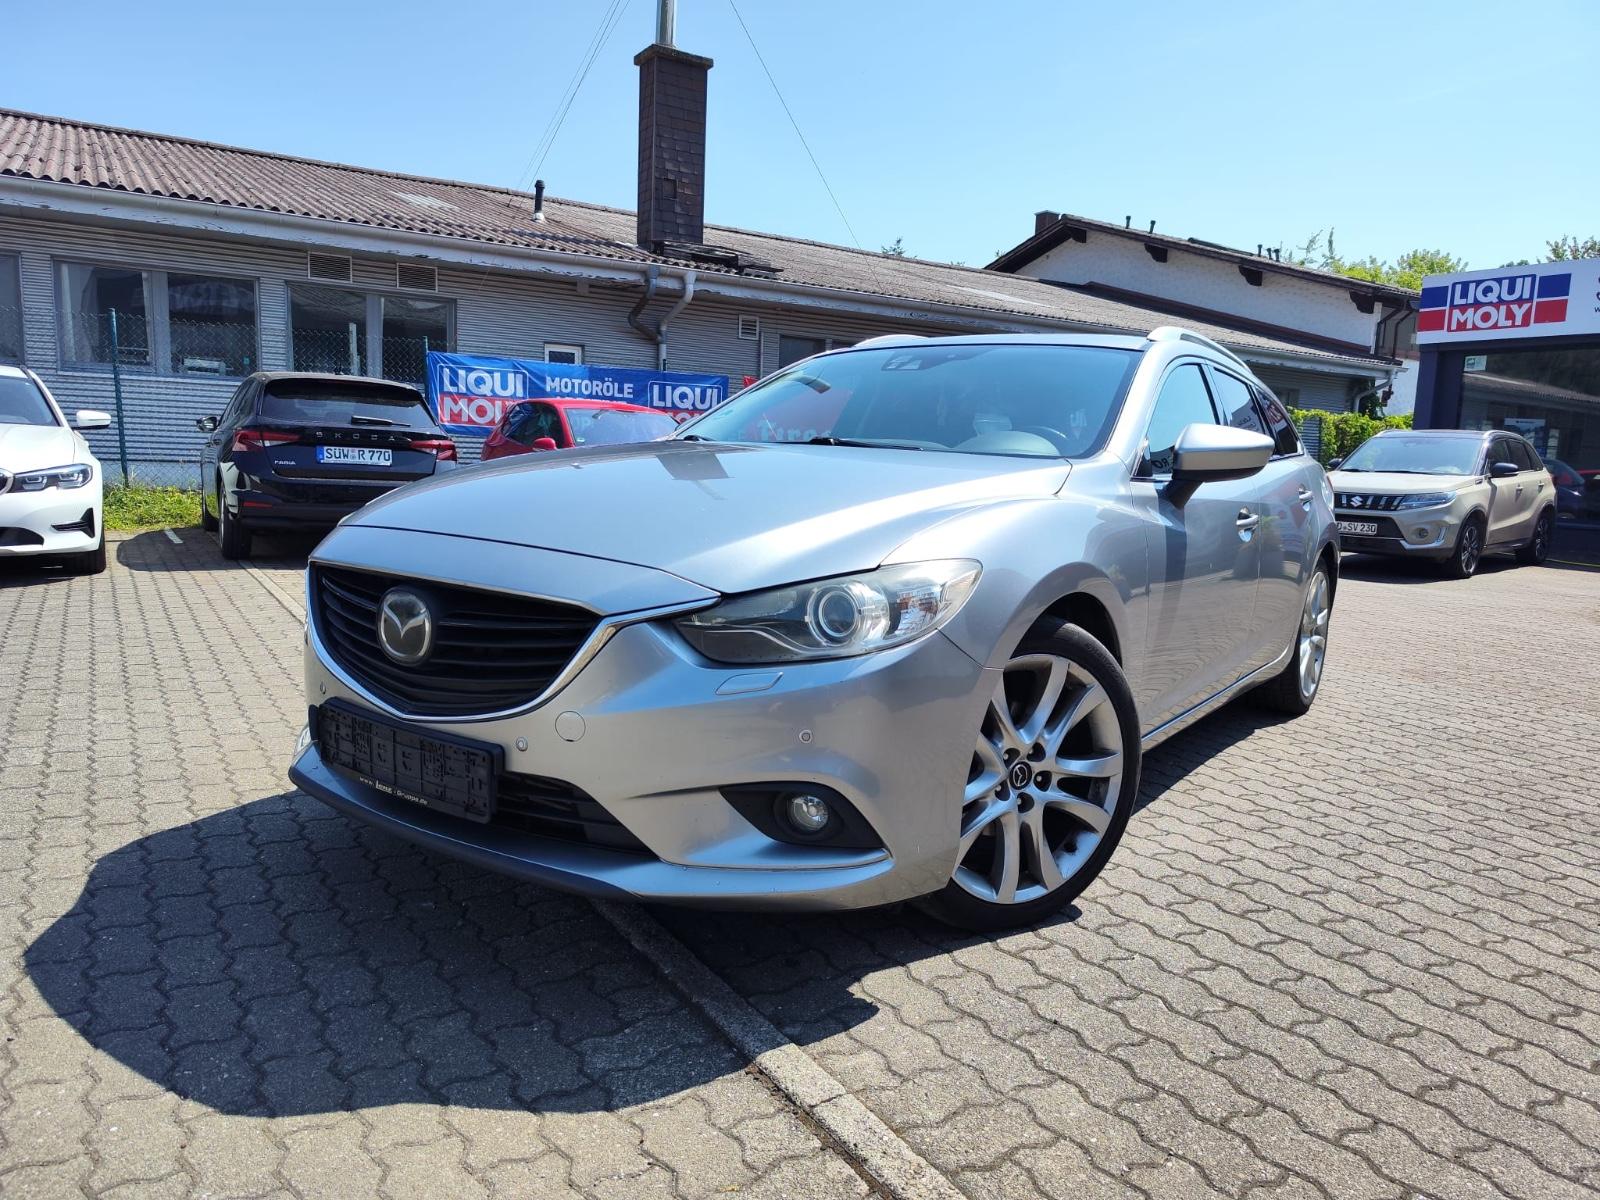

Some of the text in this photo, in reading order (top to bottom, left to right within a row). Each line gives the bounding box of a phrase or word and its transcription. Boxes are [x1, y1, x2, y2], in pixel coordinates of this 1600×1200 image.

[1454, 277, 1532, 305] LIQUI
[1451, 303, 1532, 330] MOLY
[443, 368, 523, 397] LIQUI
[545, 375, 634, 398] MOTORÖLE
[443, 397, 509, 424] MOL
[653, 385, 718, 410] LIQUI
[325, 447, 391, 461] SÜW R 770
